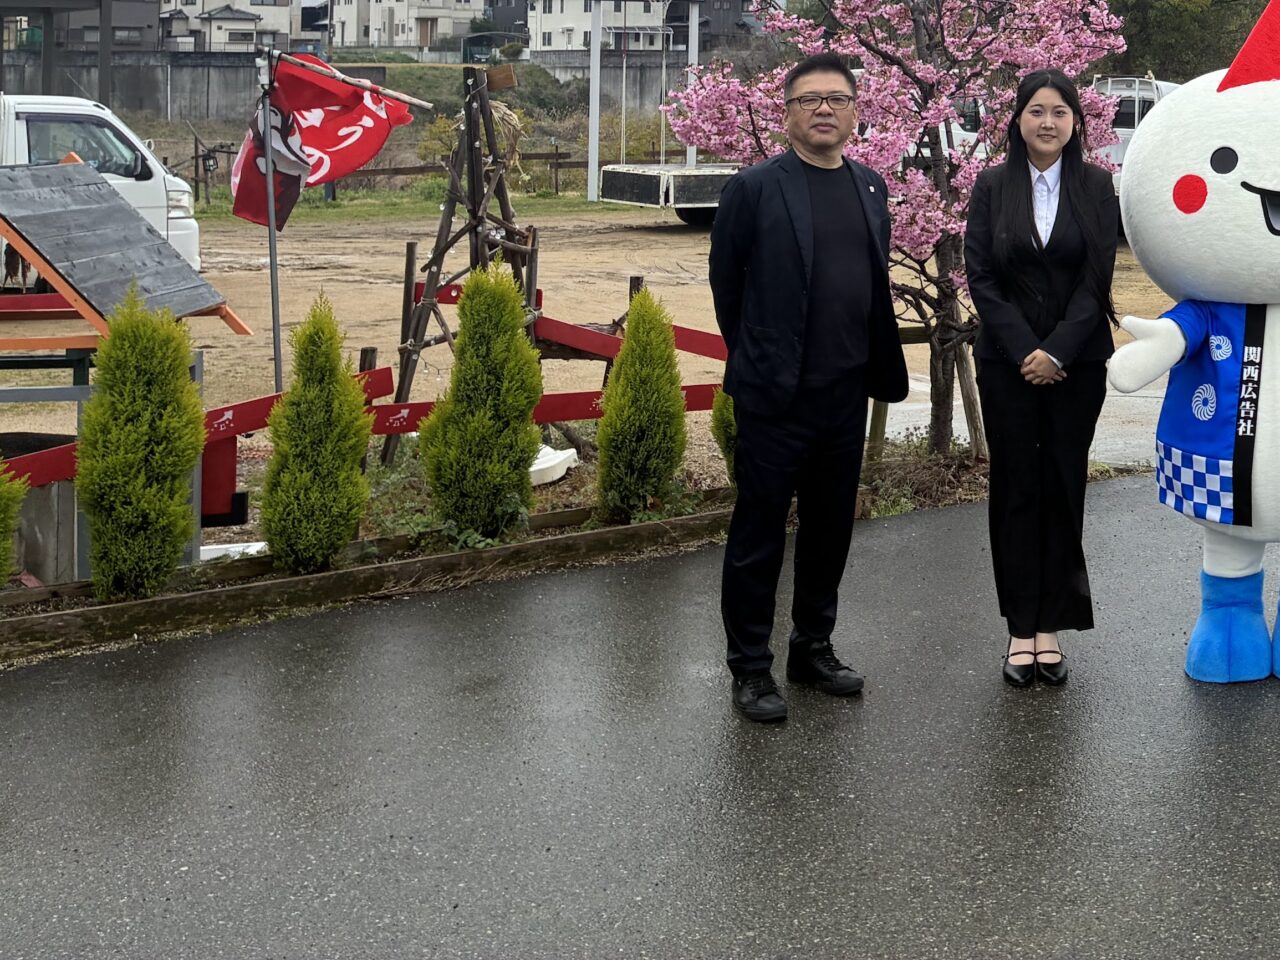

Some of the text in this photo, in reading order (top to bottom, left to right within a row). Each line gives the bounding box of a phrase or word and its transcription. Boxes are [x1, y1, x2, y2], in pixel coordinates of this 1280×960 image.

[1237, 345, 1262, 436] 関西広告社
